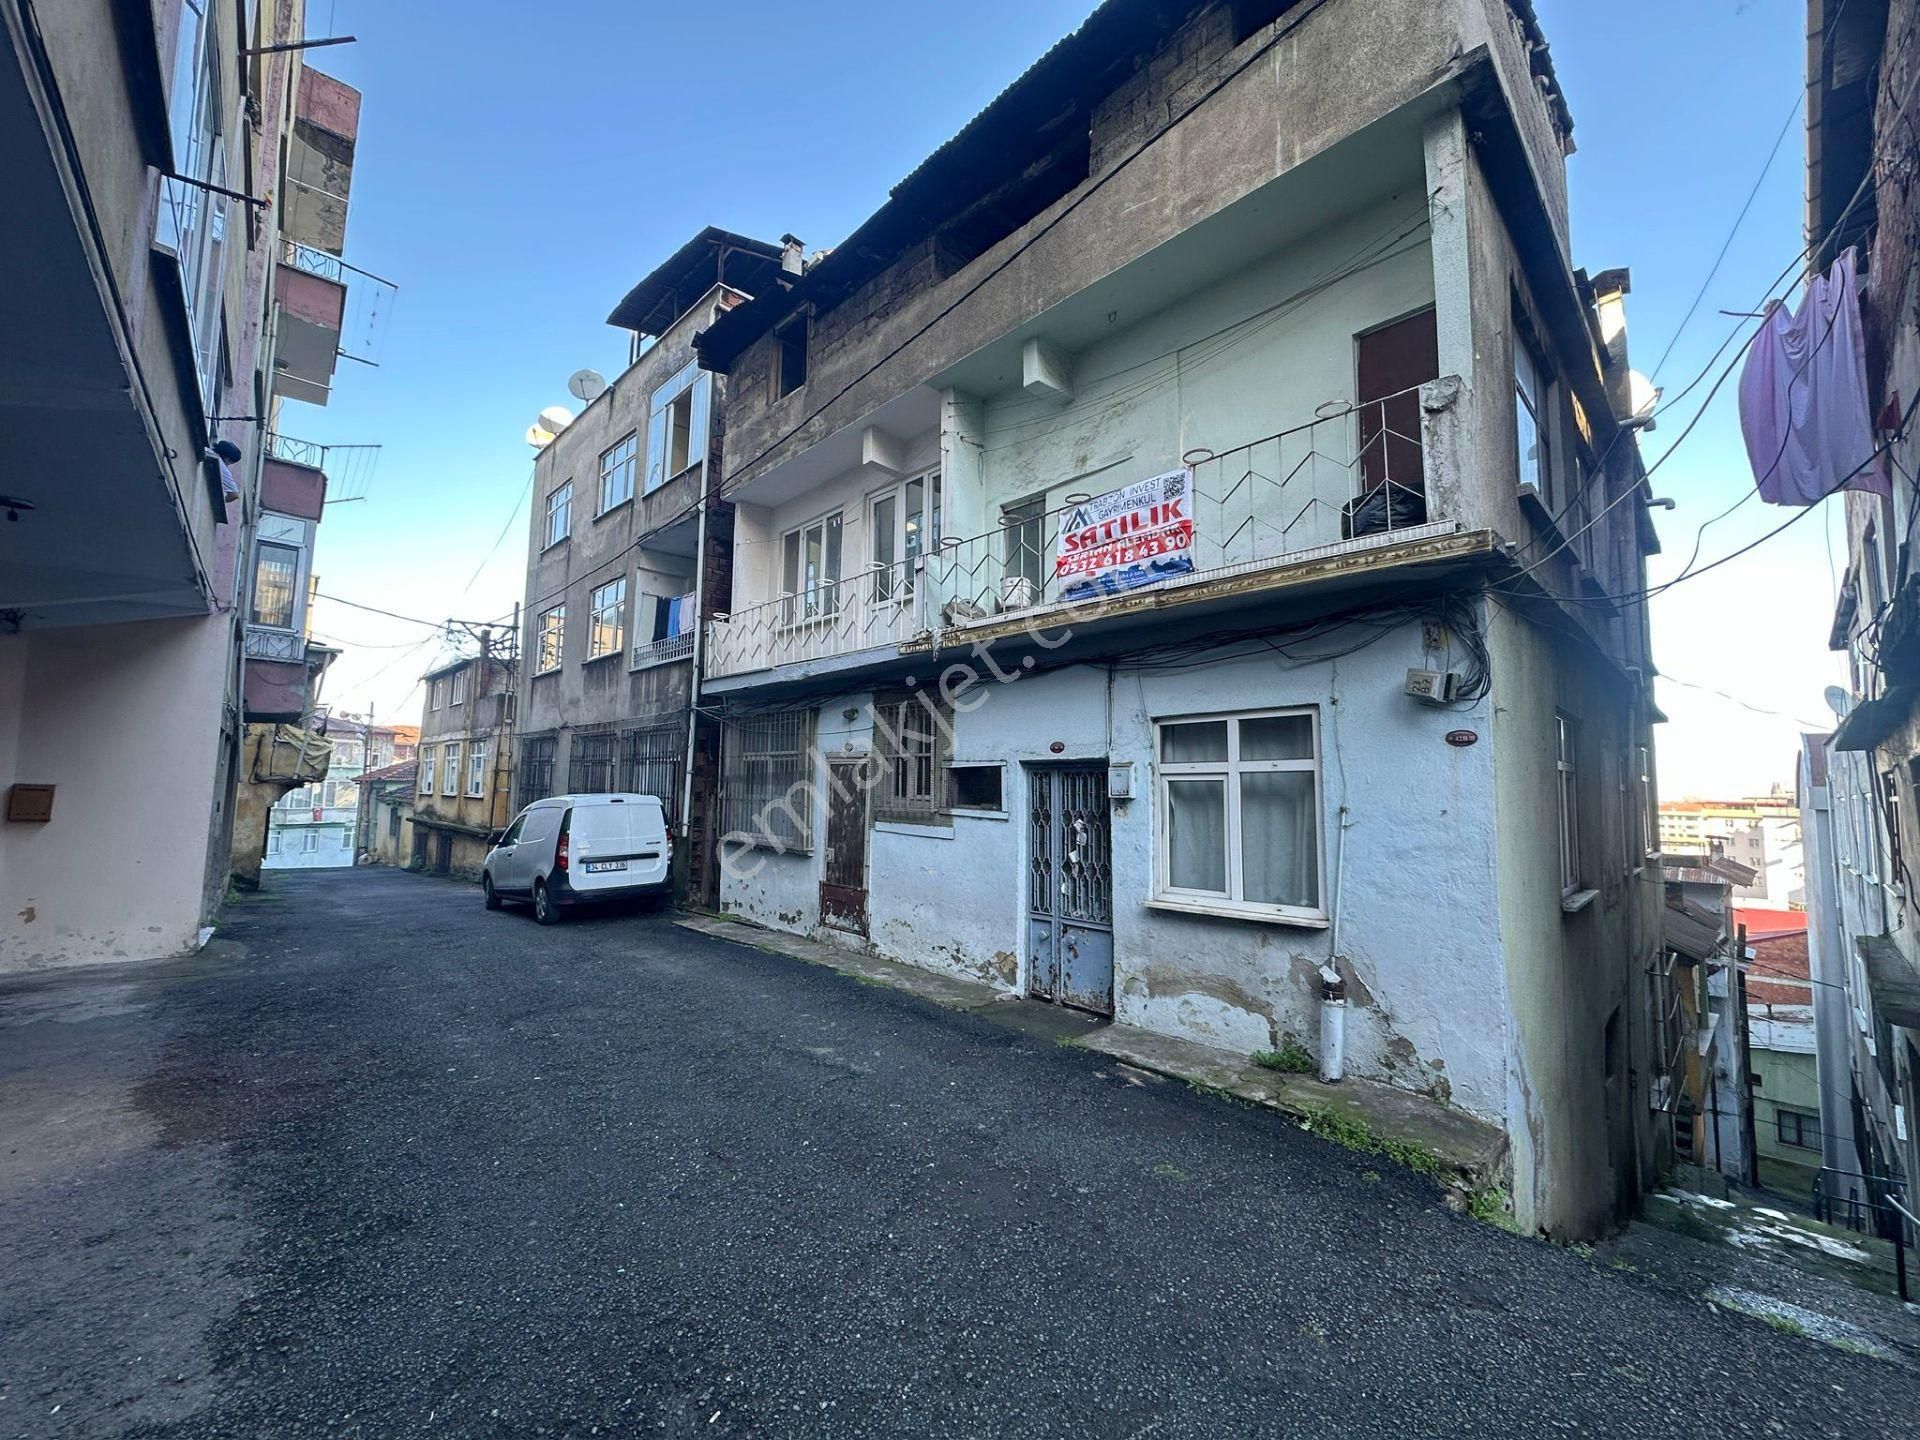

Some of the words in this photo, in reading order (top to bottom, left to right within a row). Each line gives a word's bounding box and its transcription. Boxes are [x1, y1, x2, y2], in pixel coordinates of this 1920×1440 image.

[1089, 489, 1126, 511] TRABZON
[1129, 479, 1161, 496] INVEST
[1065, 498, 1184, 552] SATILIK
[1060, 557, 1097, 576] 0532
[1103, 550, 1134, 567] 618
[1139, 540, 1160, 558] 43
[1165, 533, 1187, 550] 90
